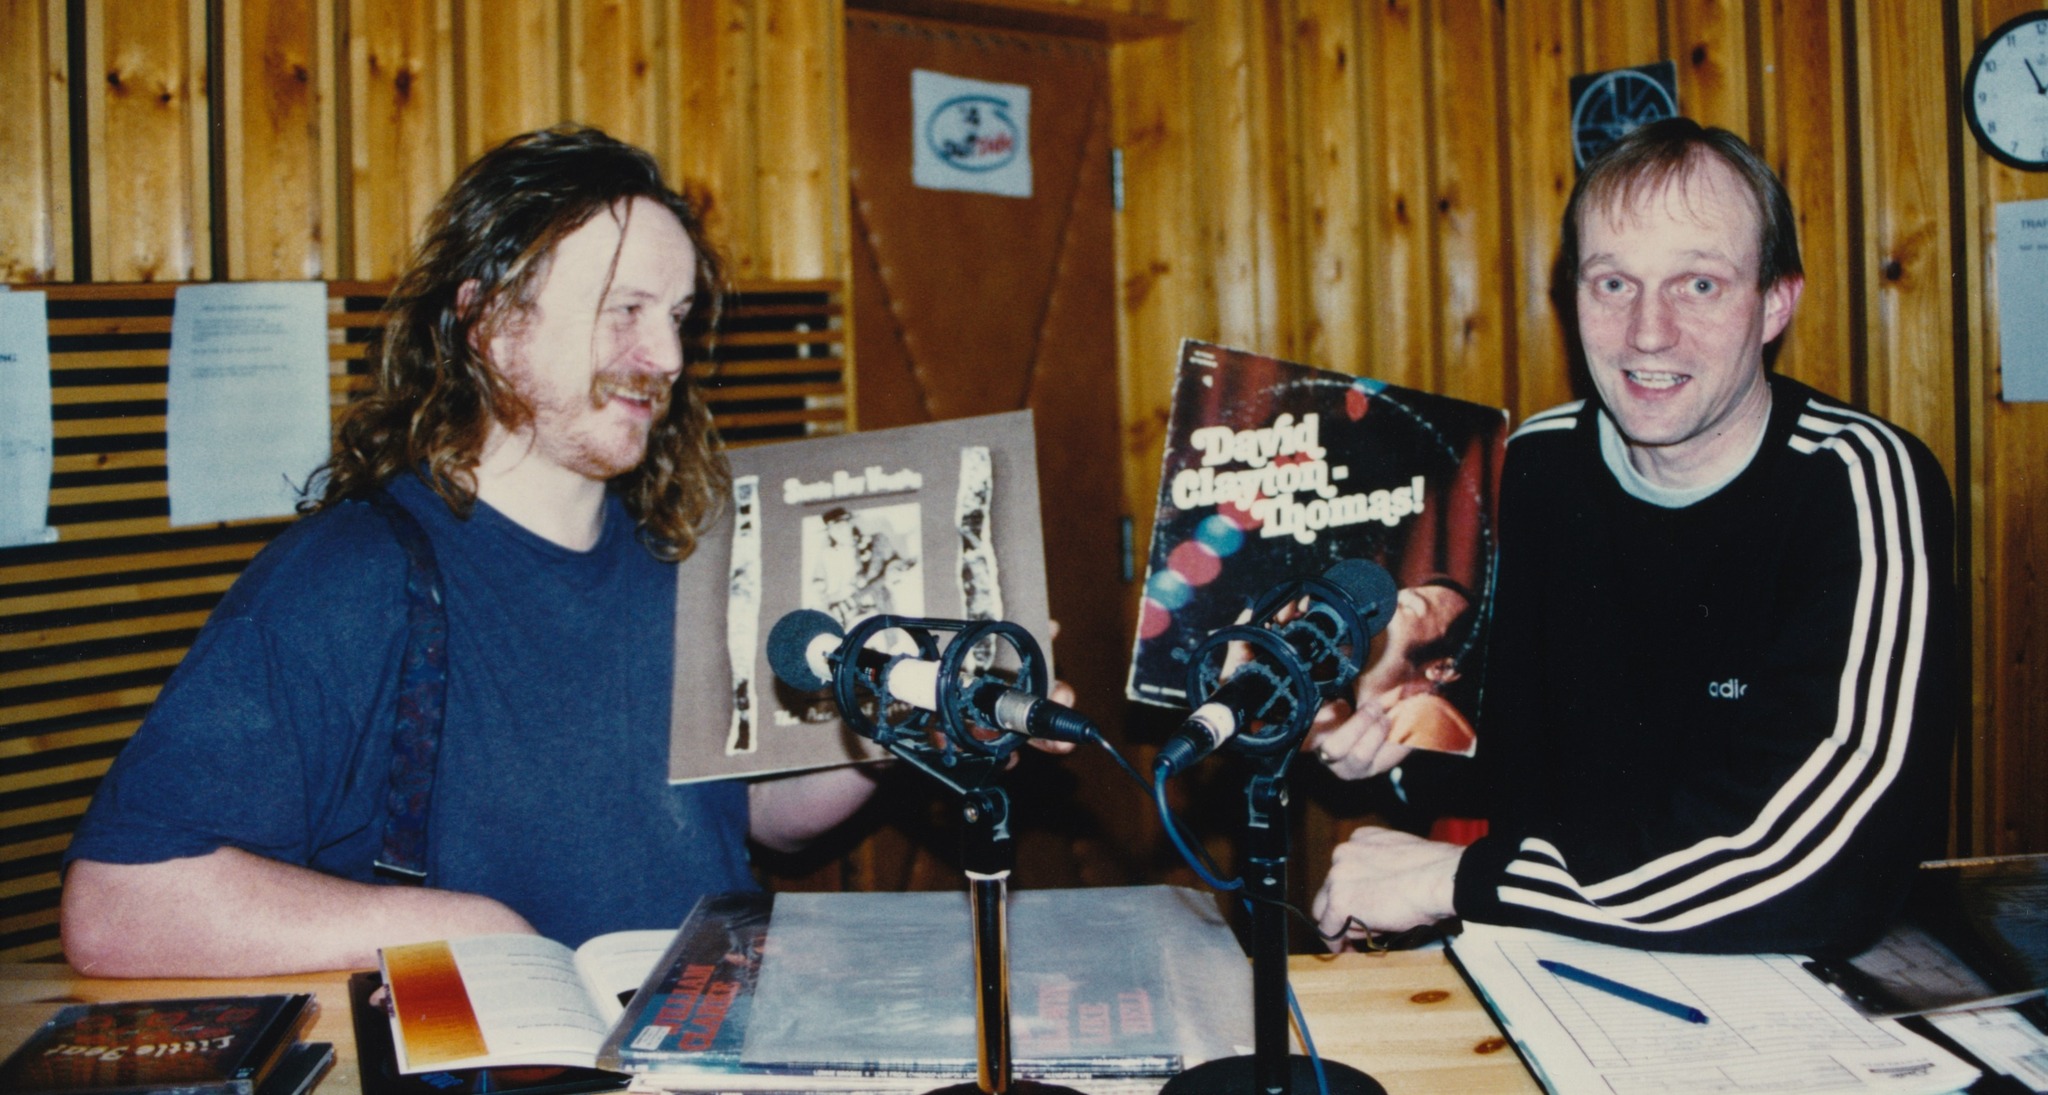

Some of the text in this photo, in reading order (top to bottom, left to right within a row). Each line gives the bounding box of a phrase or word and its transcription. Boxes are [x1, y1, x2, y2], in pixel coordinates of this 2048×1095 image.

[2036, 22, 2047, 34] 12
[2006, 34, 2016, 46] 11
[1985, 60, 1997, 72] 10
[1978, 91, 1987, 103] 9
[1987, 120, 1996, 133] 8
[2011, 140, 2018, 153] 7
[1191, 412, 1326, 468] David
[1250, 475, 1425, 544] Thomas!
[678, 981, 742, 1051] CLARKE
[44, 1035, 235, 1061] Little Feat
